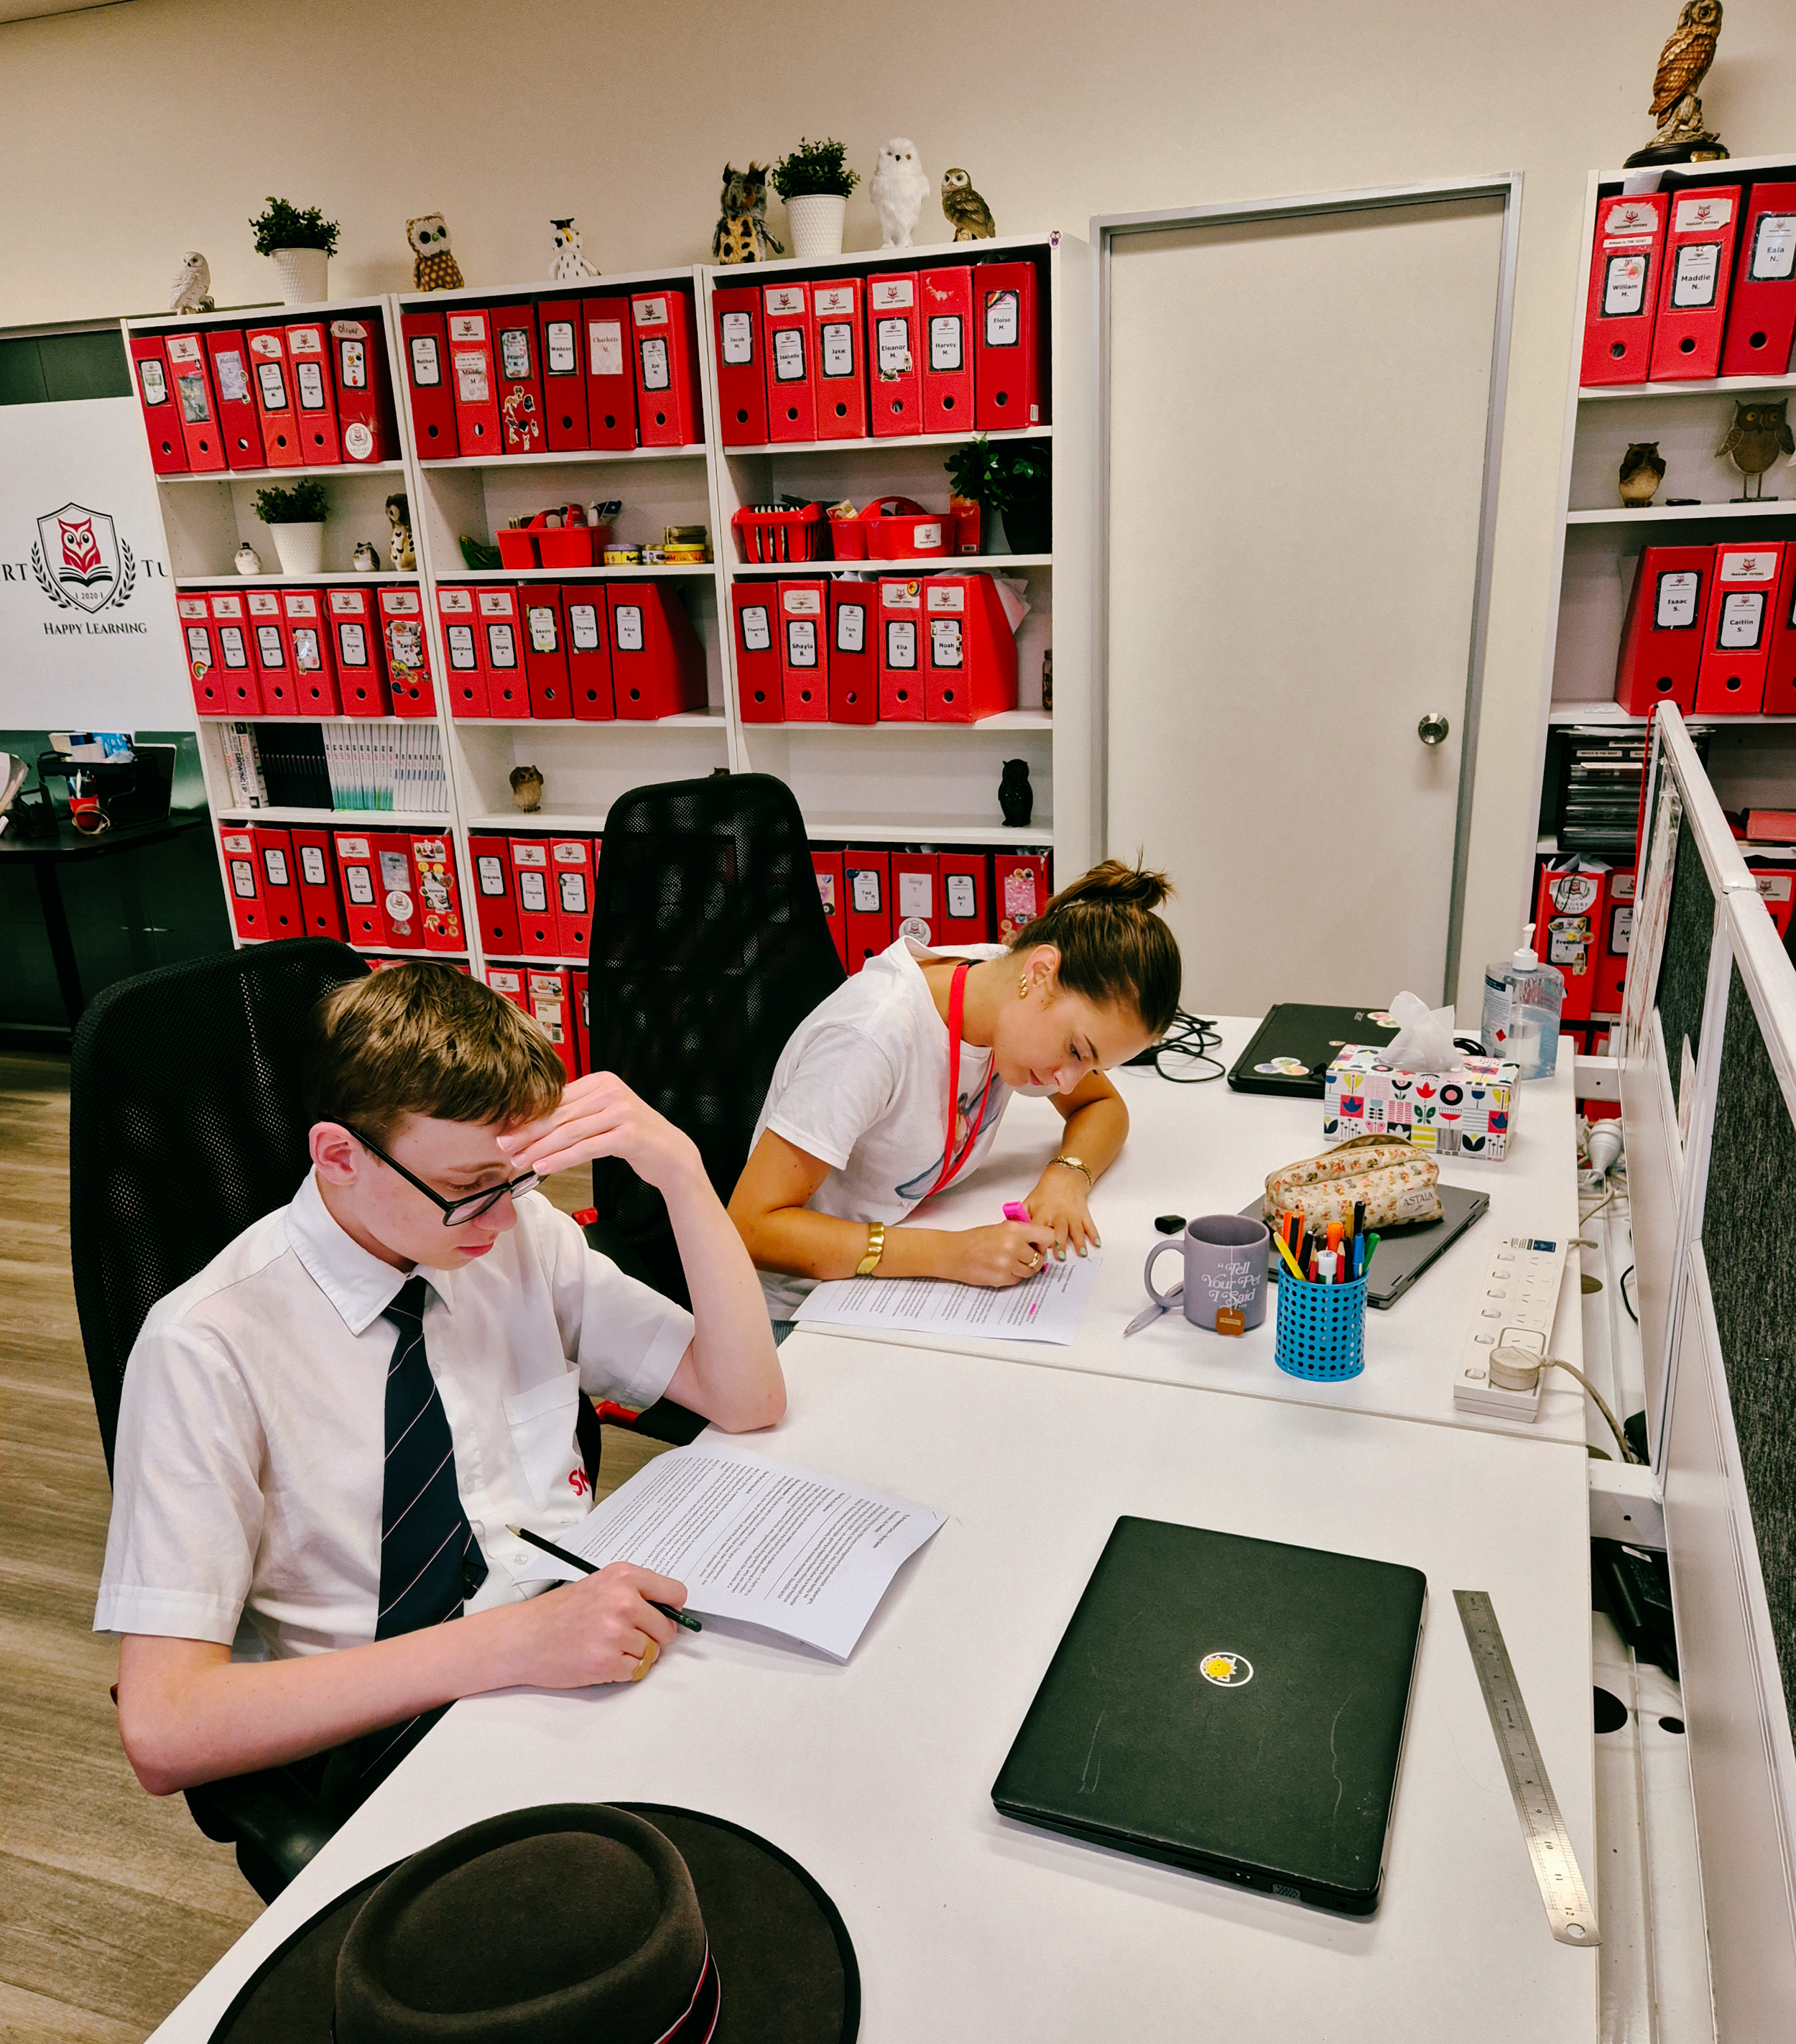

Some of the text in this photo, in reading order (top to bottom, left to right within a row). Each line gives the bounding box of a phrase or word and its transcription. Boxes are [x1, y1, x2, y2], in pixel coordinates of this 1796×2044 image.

[338, 325, 359, 335] Oliver
[81, 591, 98, 600] 2020
[1403, 1192, 1434, 1207] ASTALA
[1201, 1274, 1236, 1290] Your
[1221, 1288, 1256, 1306] Said
[1544, 1841, 1554, 1850] 10
[1564, 1907, 1575, 1916] 12
